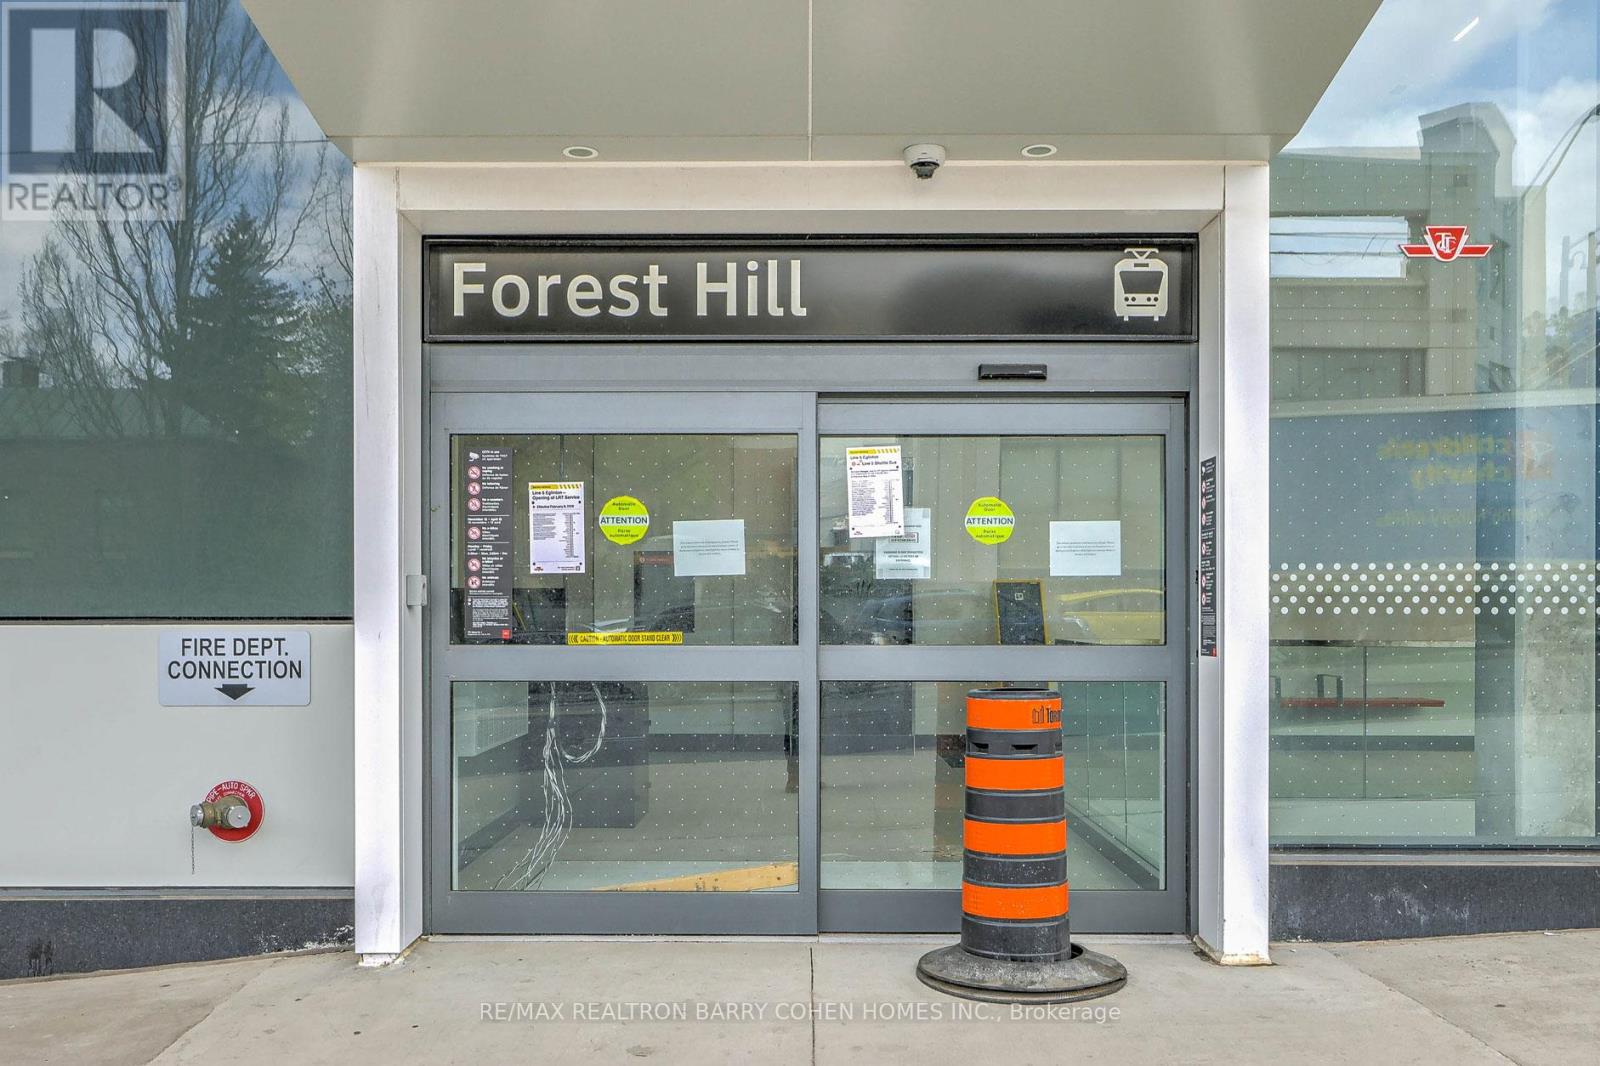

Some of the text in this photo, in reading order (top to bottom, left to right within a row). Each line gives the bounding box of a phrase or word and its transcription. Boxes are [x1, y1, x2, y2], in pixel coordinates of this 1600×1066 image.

[453, 259, 807, 317] Forest Hill
[181, 637, 289, 657] FIRE DEPT.
[168, 660, 302, 679] CONNECTION
[240, 784, 256, 799] SPKR
